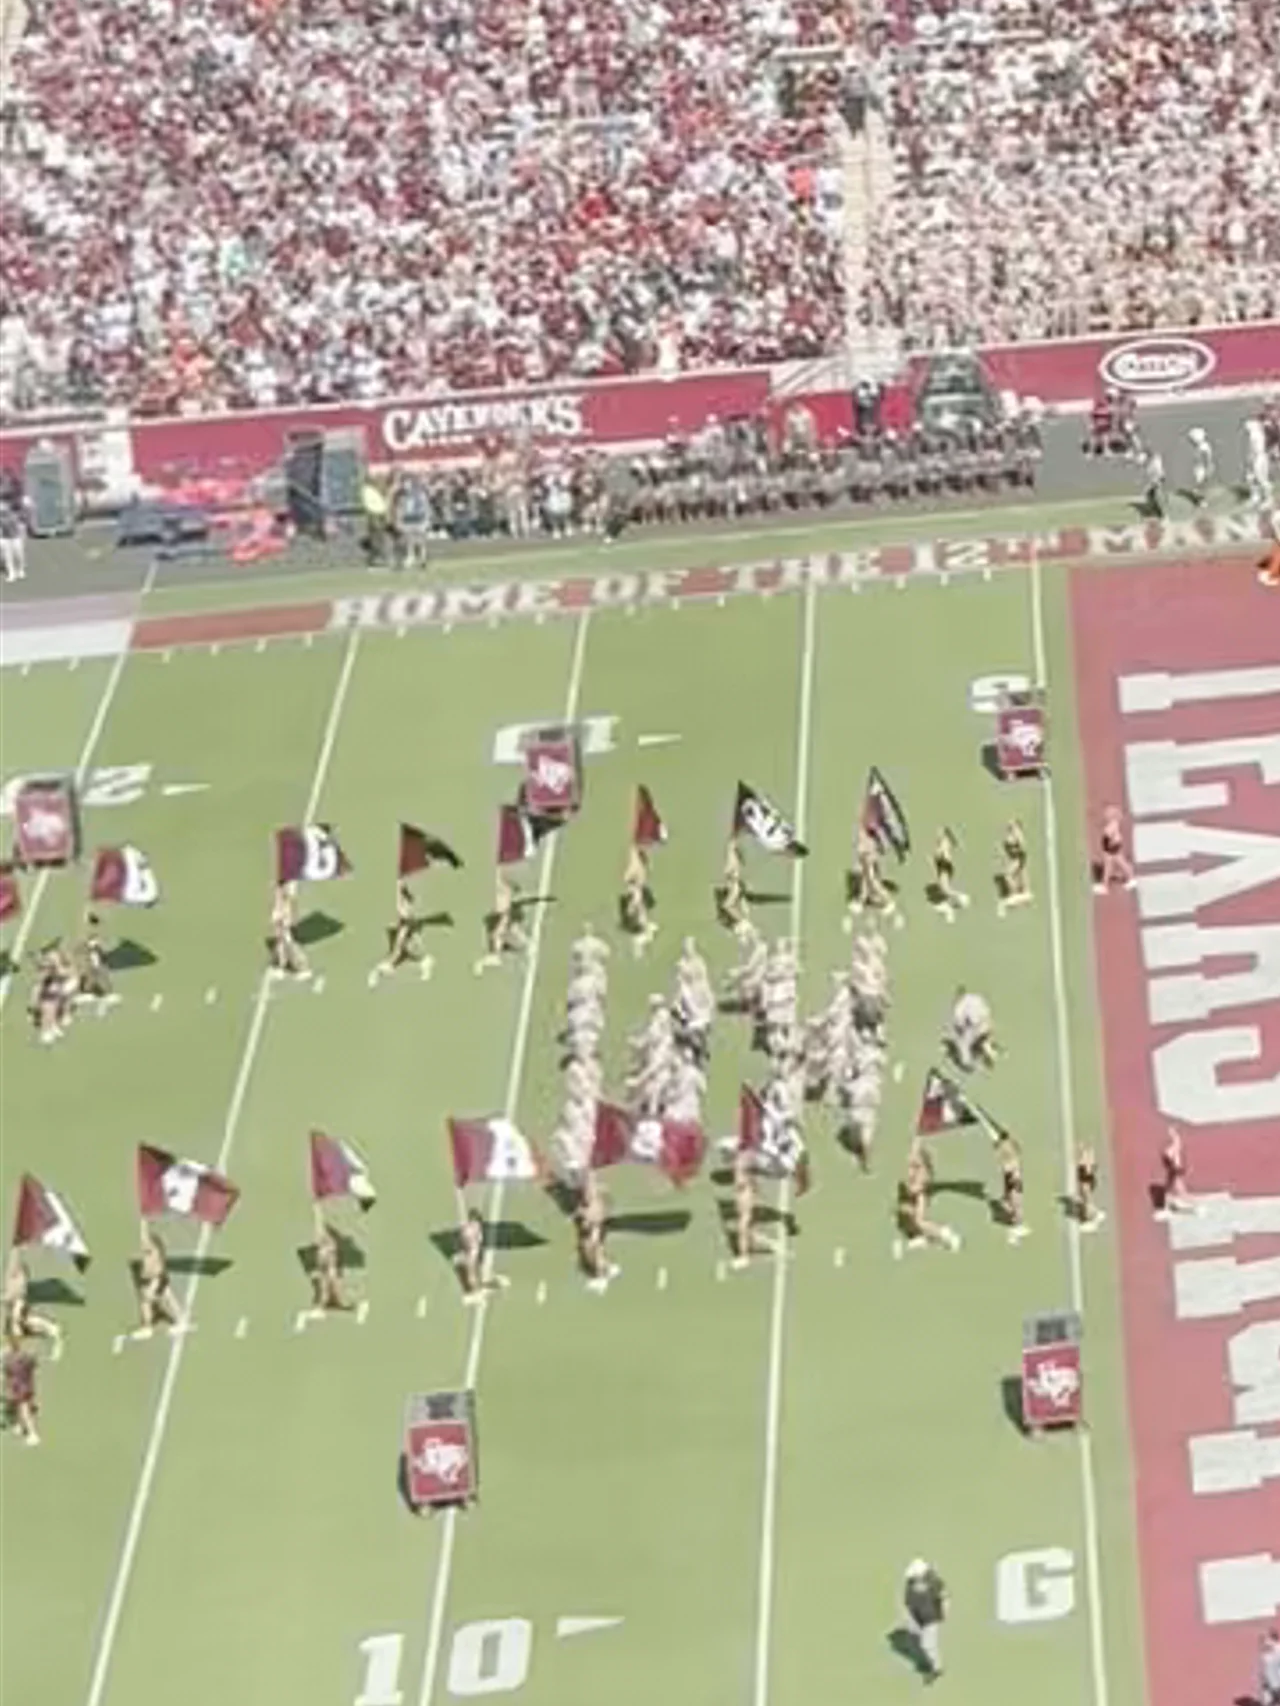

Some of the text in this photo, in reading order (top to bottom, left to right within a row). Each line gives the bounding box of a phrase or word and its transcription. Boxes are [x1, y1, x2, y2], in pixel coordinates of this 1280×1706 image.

[330, 511, 1270, 630] HOME OF THE 12TH MAN
[996, 1546, 1076, 1624] G
